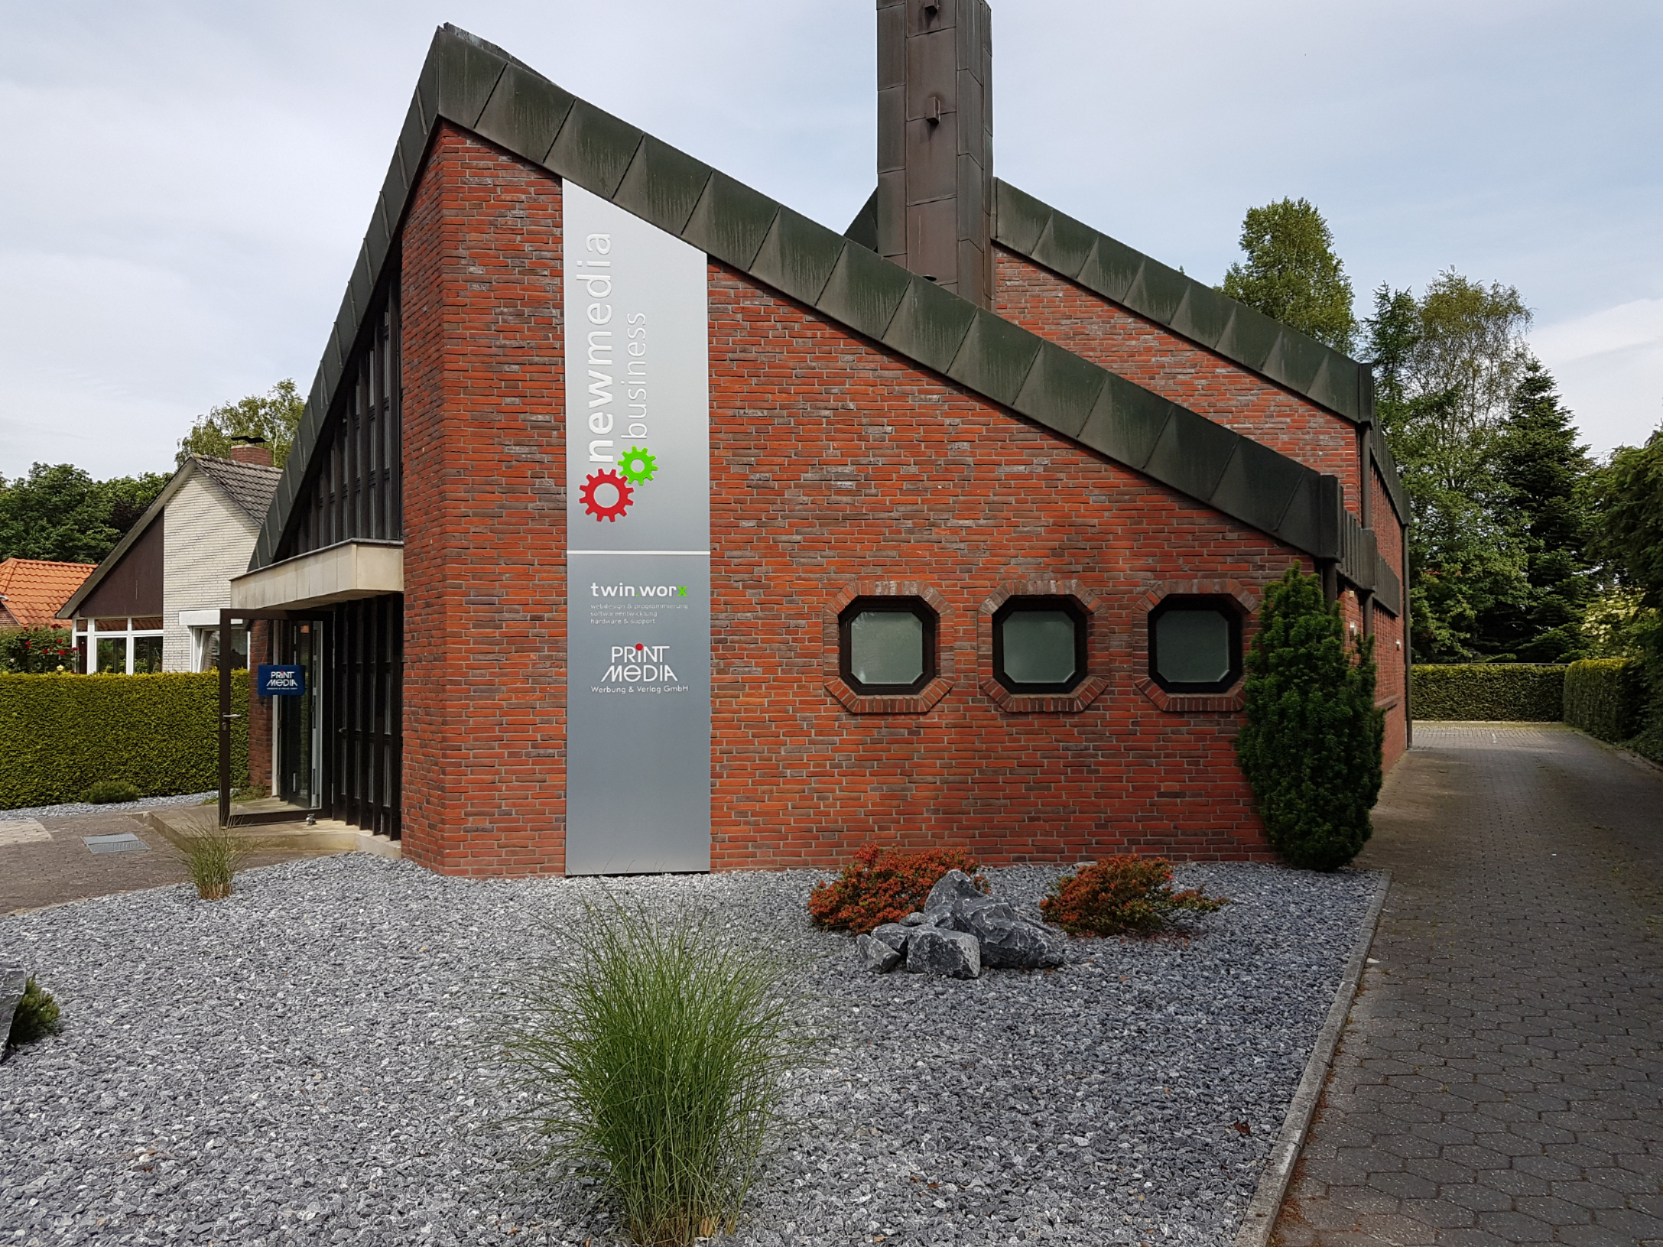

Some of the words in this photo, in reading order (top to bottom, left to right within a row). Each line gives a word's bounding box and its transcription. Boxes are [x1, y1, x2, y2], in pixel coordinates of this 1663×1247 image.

[576, 233, 614, 463] newmedia
[620, 312, 648, 440] business
[590, 686, 627, 694] Werbung
[636, 685, 662, 694] Verlag
[663, 684, 689, 692] GmbH
